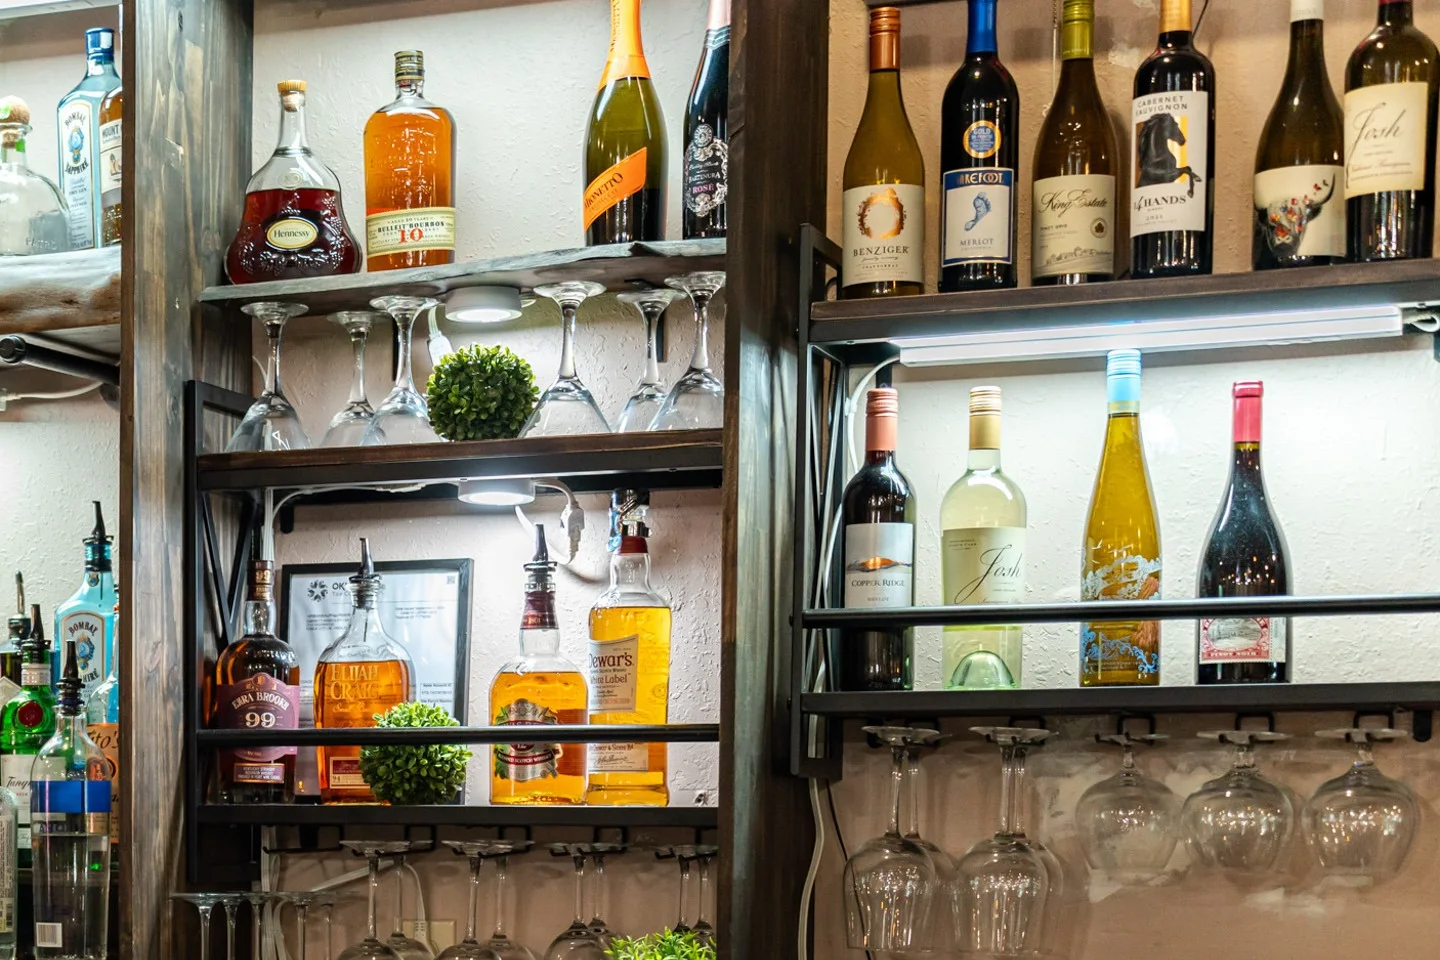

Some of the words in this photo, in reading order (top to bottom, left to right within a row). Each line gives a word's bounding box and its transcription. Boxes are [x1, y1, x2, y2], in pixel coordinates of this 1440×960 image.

[1137, 95, 1184, 108] CABERNET
[1135, 103, 1188, 116] SAUVIGNON
[1346, 102, 1408, 189] Josh
[1038, 189, 1073, 218] King
[1067, 188, 1108, 208] Estate
[1144, 196, 1187, 207] HANDS
[273, 229, 310, 240] Hennessy
[378, 224, 406, 233] BULLEIT
[398, 228, 423, 243] 10
[960, 238, 994, 247] MERLOT
[853, 245, 910, 257] BENZIGER
[954, 543, 1023, 605] Josh
[851, 579, 881, 588] COPPER
[882, 578, 906, 587] RIDGE
[68, 620, 99, 637] BOMBAY
[331, 664, 379, 682] ELIJAH
[605, 674, 628, 684] Label
[330, 681, 379, 702] CRAIG
[245, 711, 276, 728] 99
